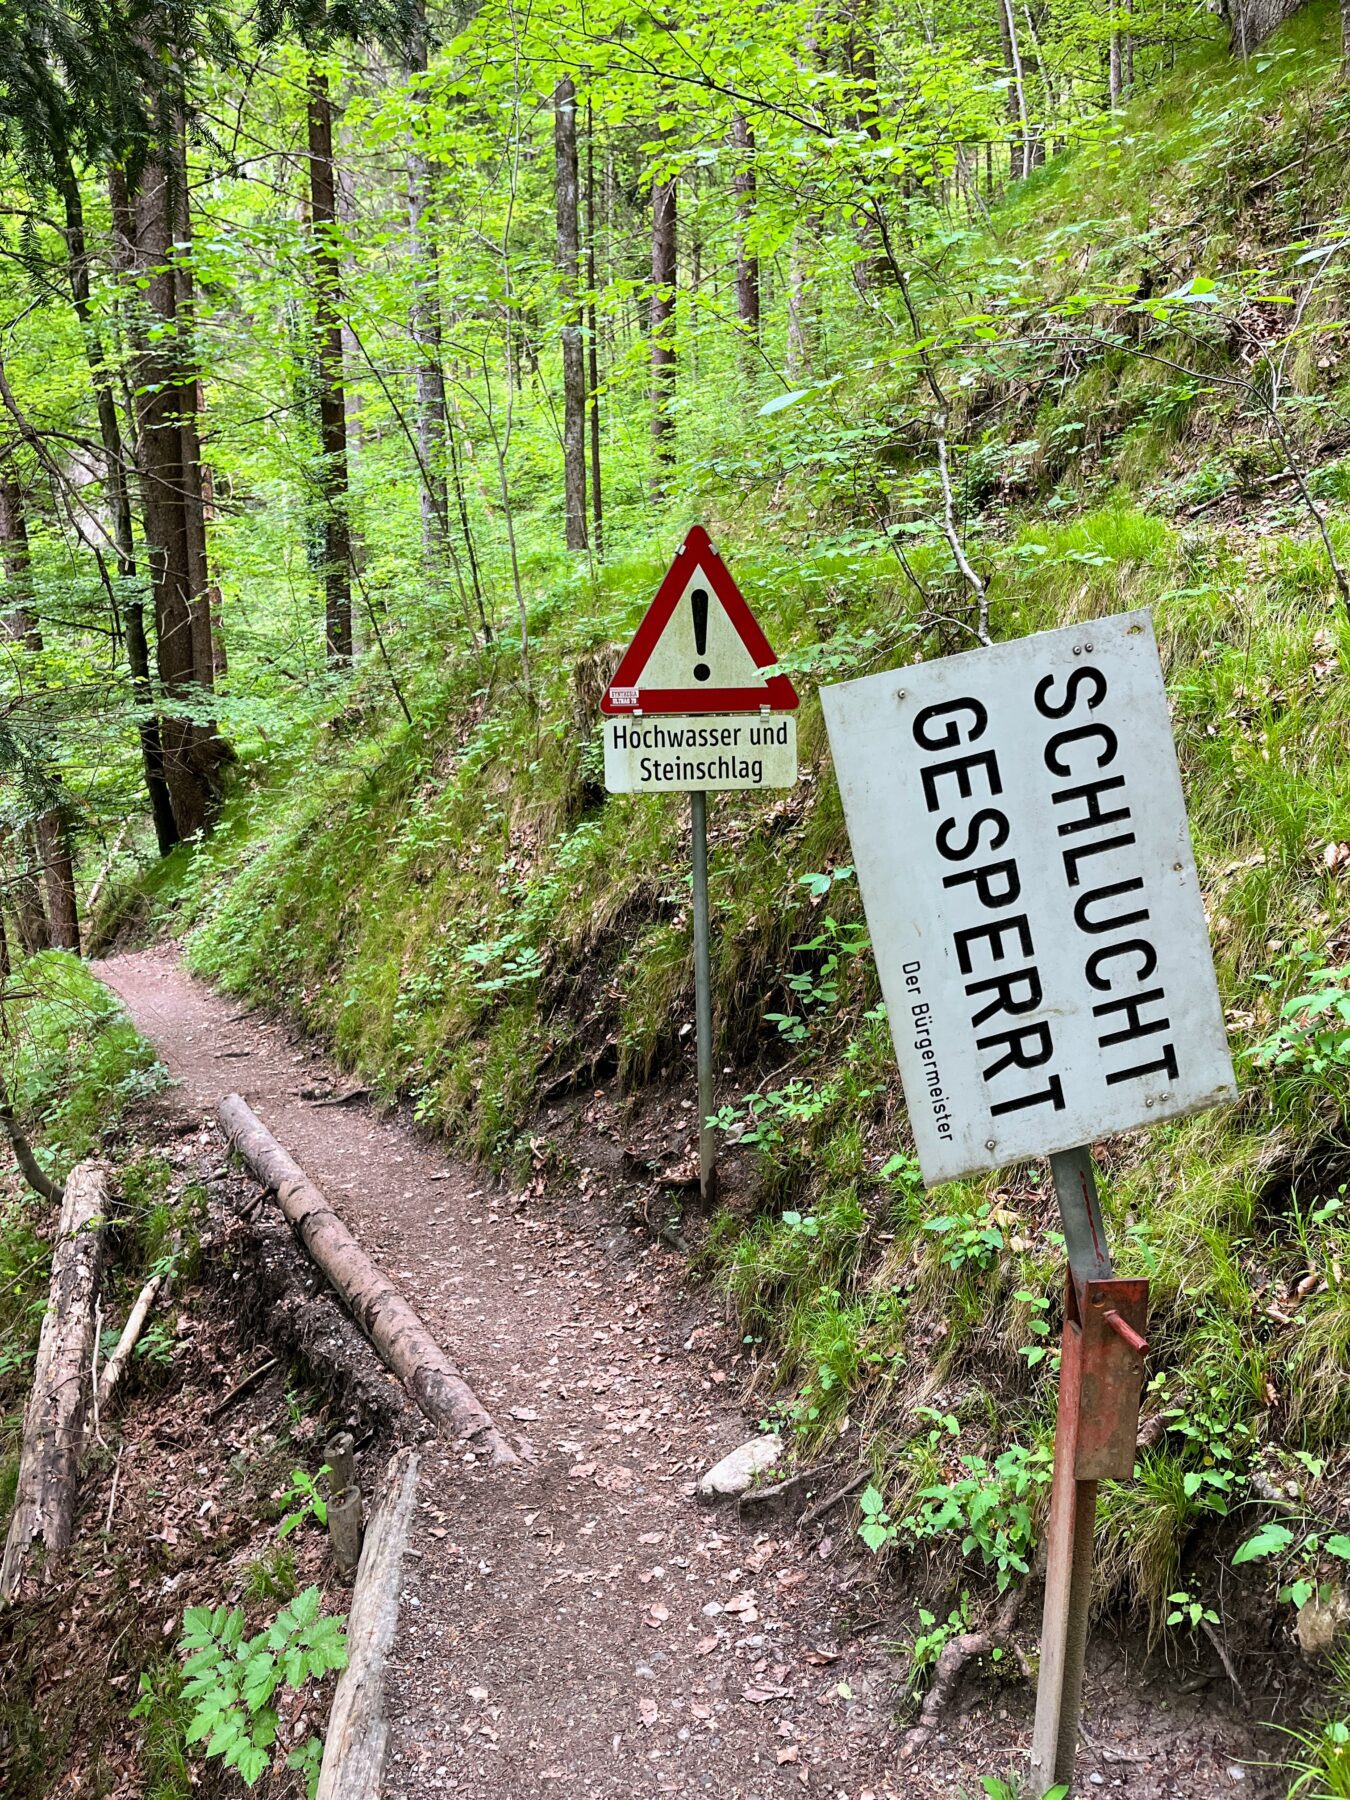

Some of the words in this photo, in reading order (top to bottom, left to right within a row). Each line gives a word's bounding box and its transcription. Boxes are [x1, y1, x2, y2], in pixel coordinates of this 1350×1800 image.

[614, 725, 741, 749] Hochwasser
[750, 722, 787, 745] und
[641, 756, 762, 783] Steinschlag
[913, 697, 1065, 1116] GESPERRT
[1035, 667, 1179, 1085] SCHLUCHT
[902, 960, 921, 994] Der
[911, 1003, 953, 1141] Bürgermeister
